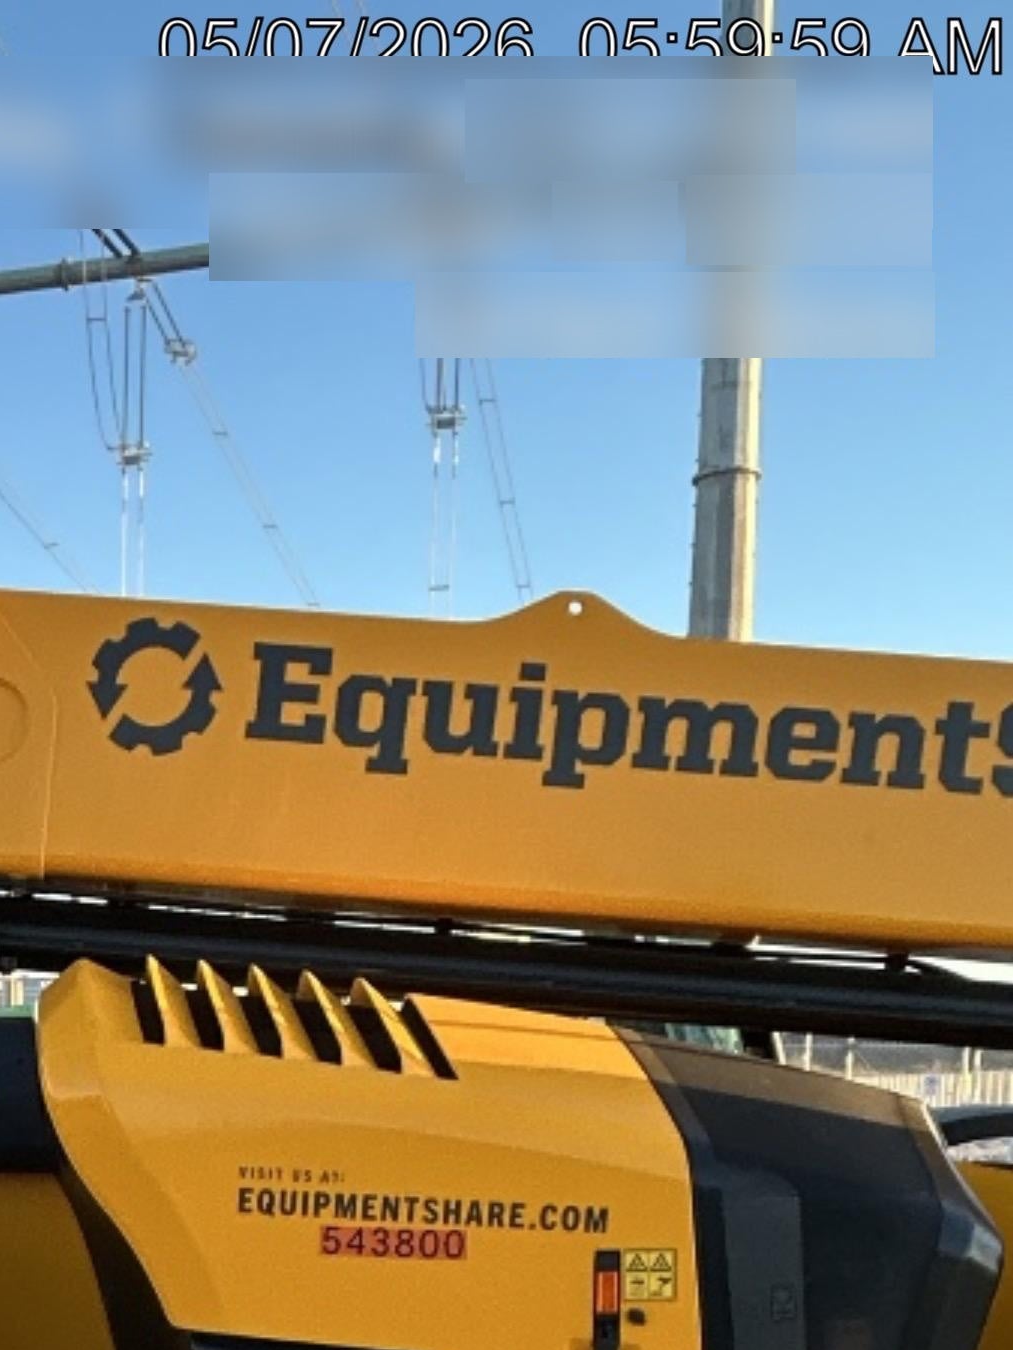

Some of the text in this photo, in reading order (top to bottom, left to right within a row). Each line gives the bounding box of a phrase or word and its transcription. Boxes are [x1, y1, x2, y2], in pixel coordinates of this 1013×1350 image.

[238, 1166, 284, 1180] VISIT
[292, 1169, 313, 1183] US
[237, 1187, 610, 1234] EQUIPMENTSHARE.COM
[321, 1225, 466, 1259] 543800
